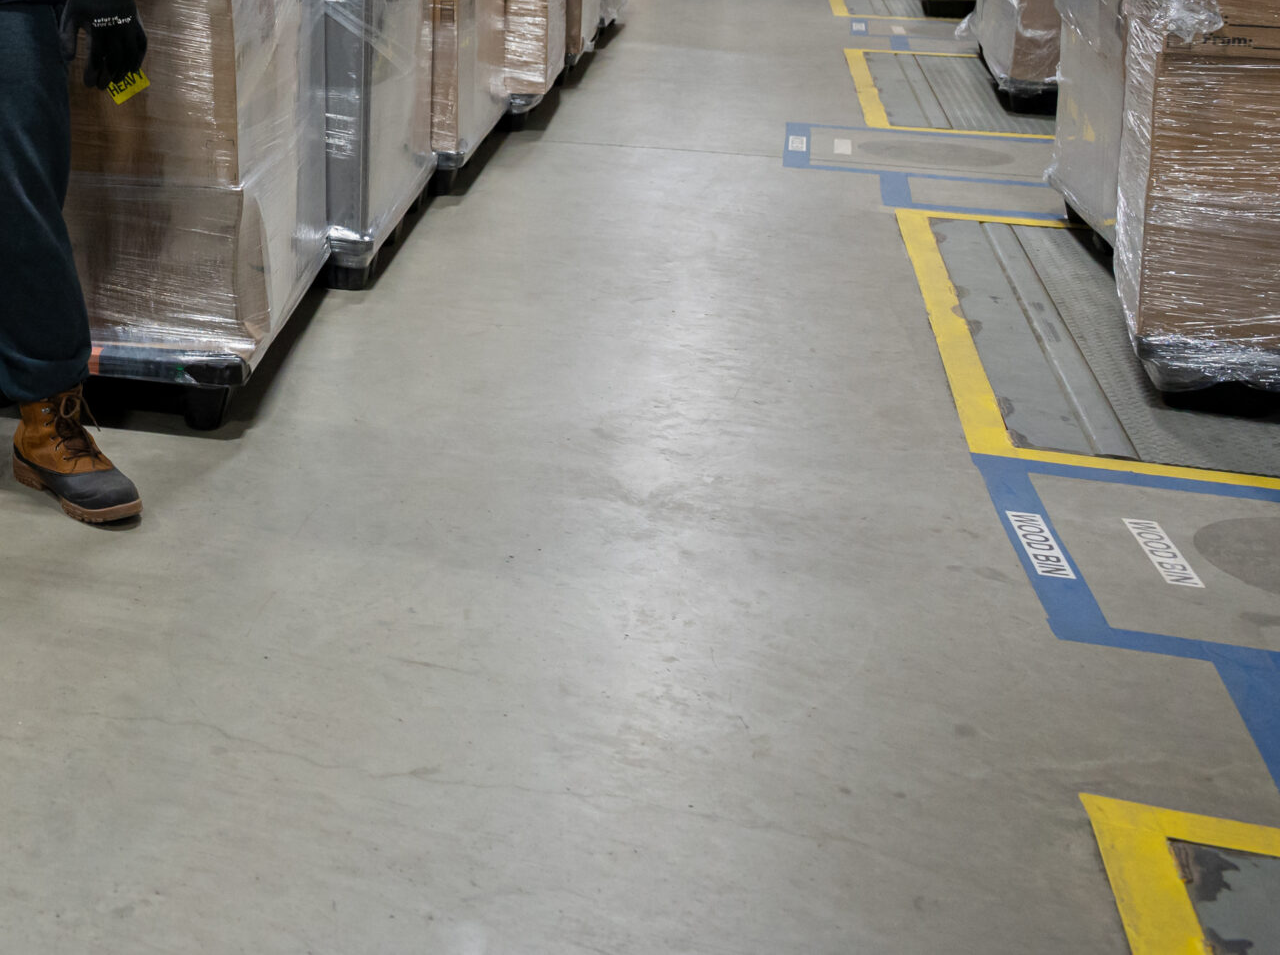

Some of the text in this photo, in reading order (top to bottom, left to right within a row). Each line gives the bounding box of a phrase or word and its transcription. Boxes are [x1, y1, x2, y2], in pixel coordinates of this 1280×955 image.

[1011, 513, 1070, 577] WOOD BIN
[1128, 520, 1200, 586] WOOD BIN
